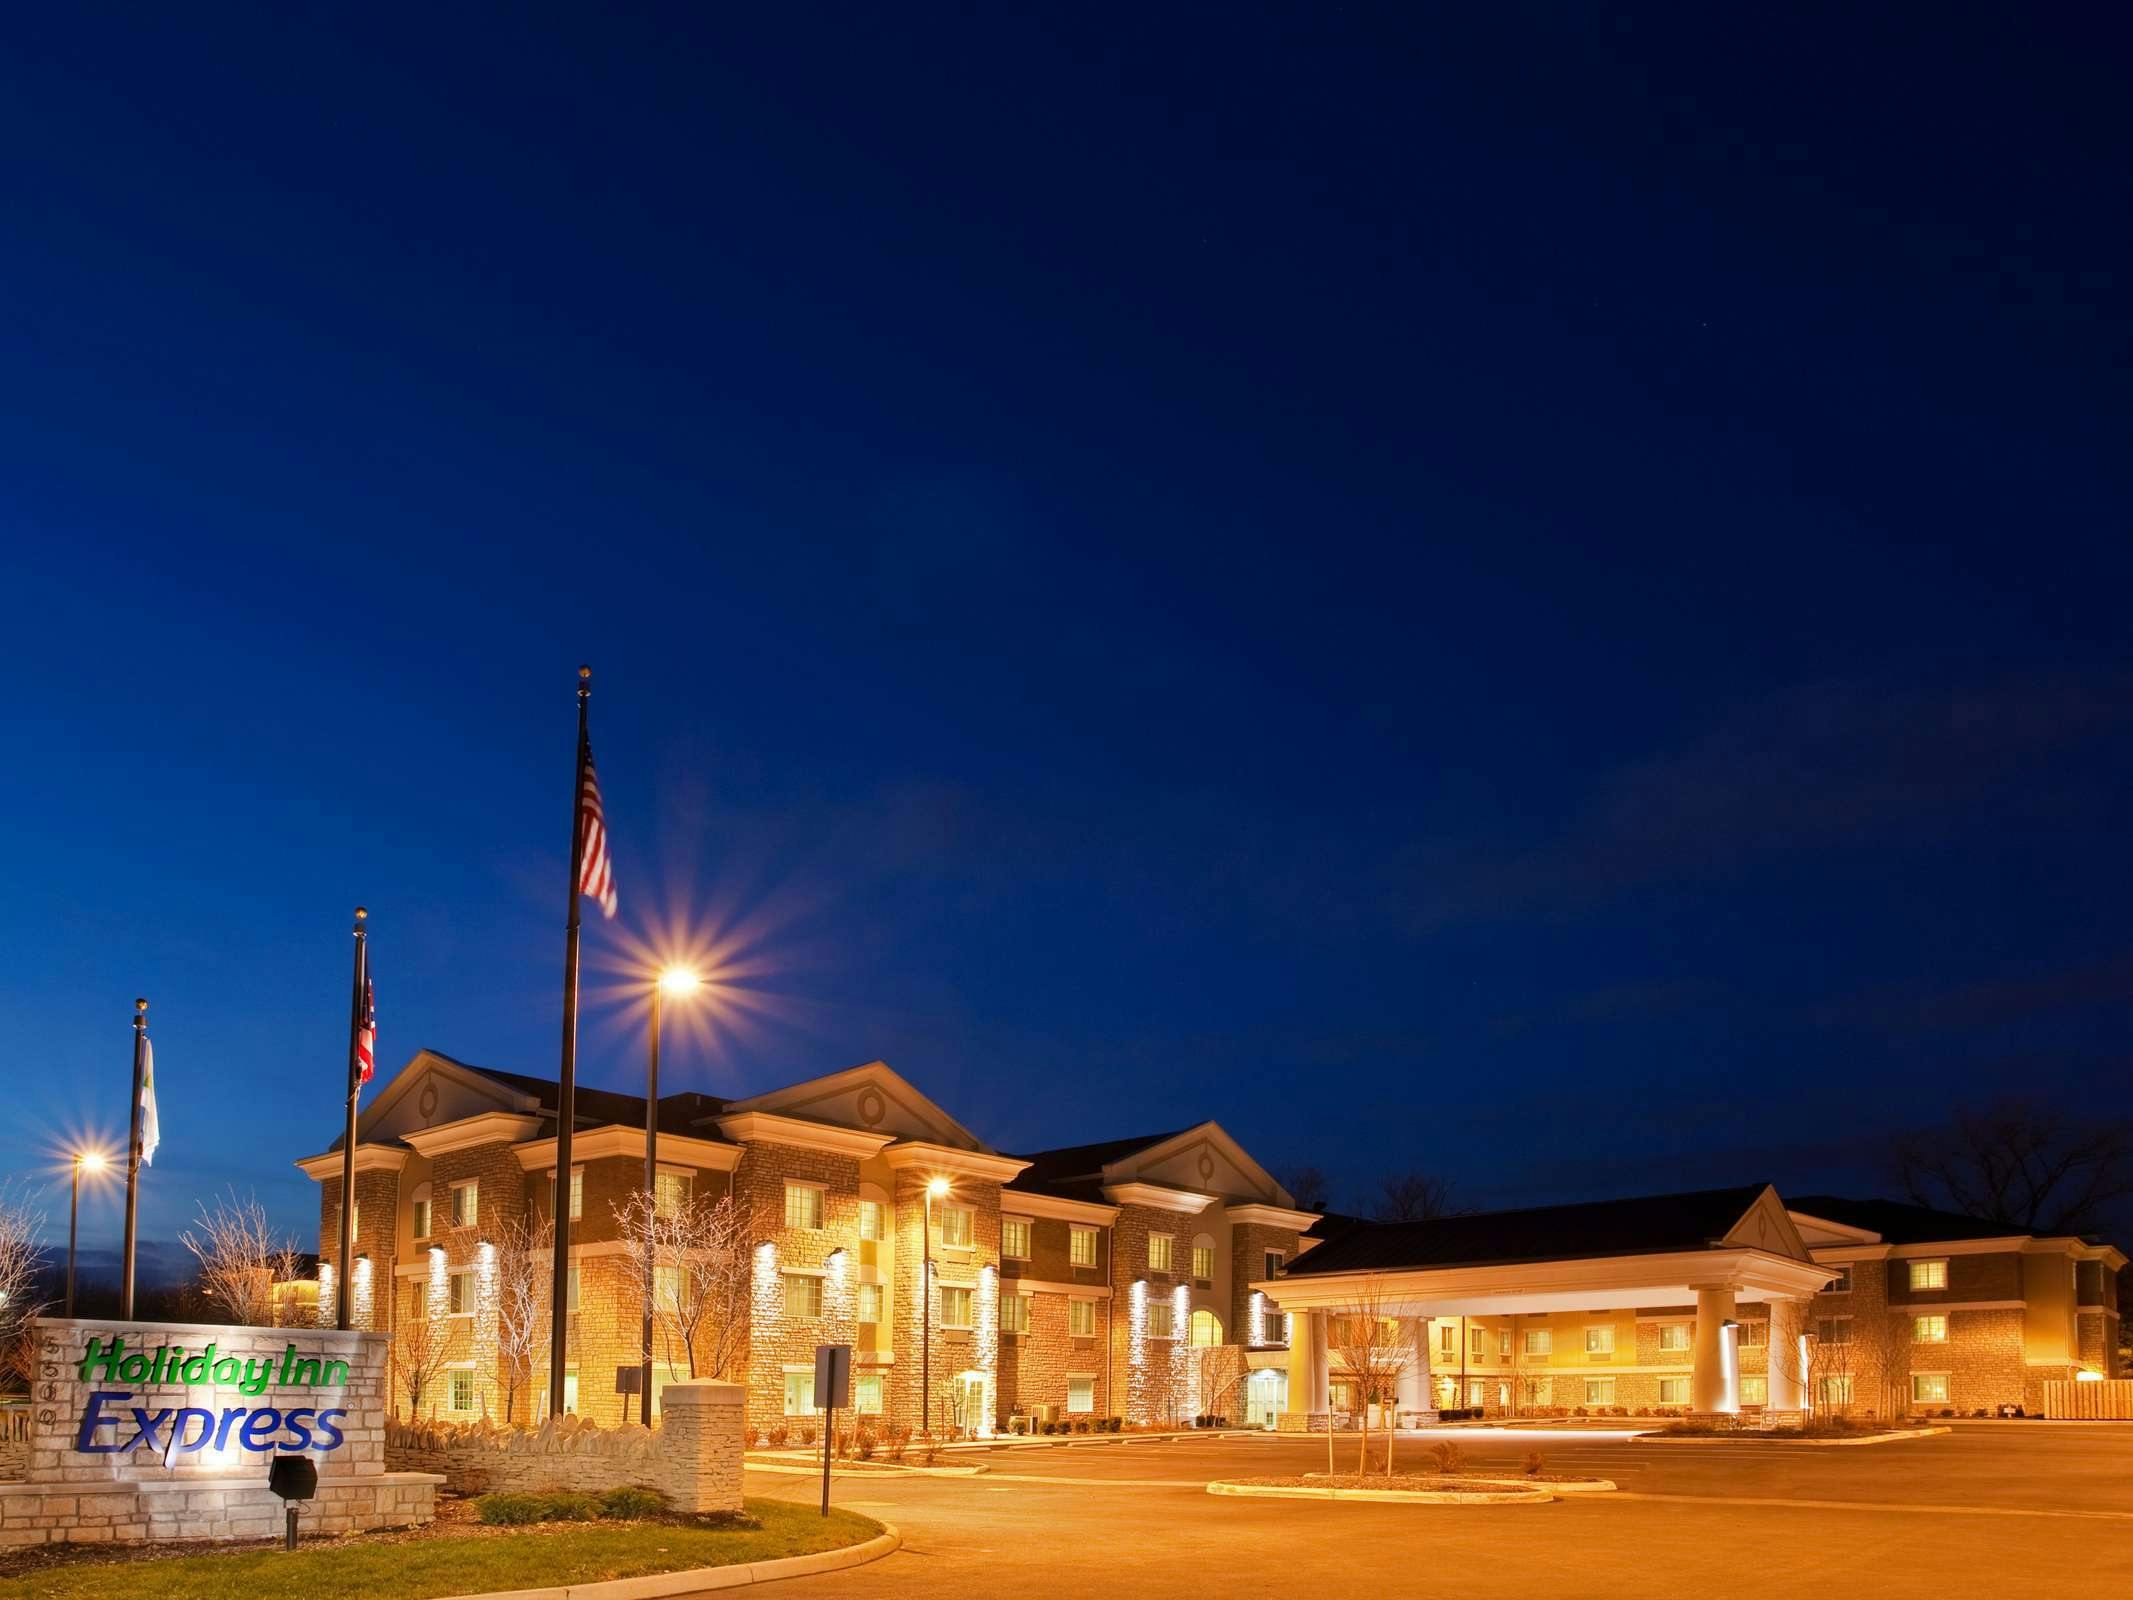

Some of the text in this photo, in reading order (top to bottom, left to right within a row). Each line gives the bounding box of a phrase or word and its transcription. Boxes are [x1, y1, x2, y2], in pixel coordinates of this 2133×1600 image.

[78, 1337, 350, 1396] Holiday Inn
[77, 1391, 347, 1469] Express
